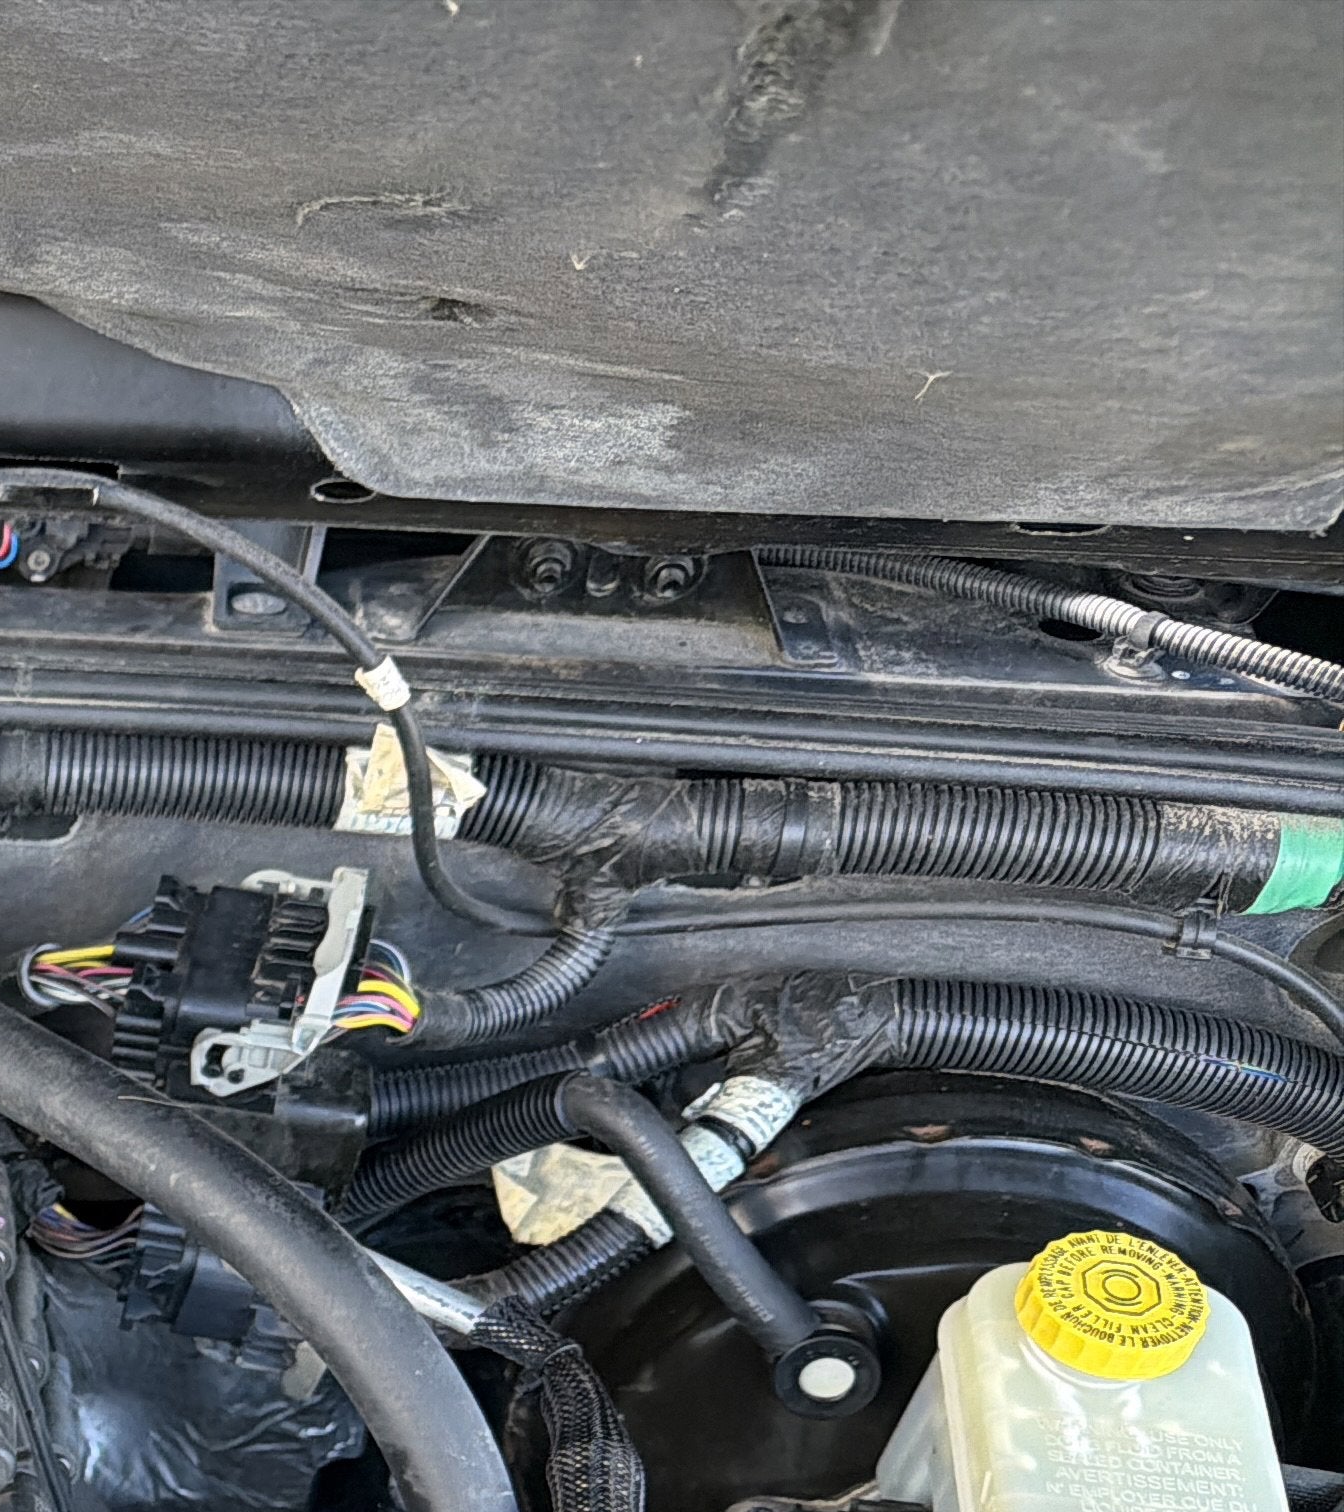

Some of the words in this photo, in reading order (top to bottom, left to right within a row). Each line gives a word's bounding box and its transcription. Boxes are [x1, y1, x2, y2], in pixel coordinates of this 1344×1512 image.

[1068, 1234, 1100, 1249] AVANT
[1106, 1234, 1121, 1245] DE
[1057, 1247, 1097, 1276] BEFORE
[1056, 1279, 1074, 1299] CAP
[1072, 1303, 1122, 1334] FILLER
[1194, 1434, 1244, 1451] ONLY
[1167, 1447, 1224, 1464] FROM
[1226, 1454, 1243, 1466] A
[1069, 1483, 1174, 1508] EMPLOYER
